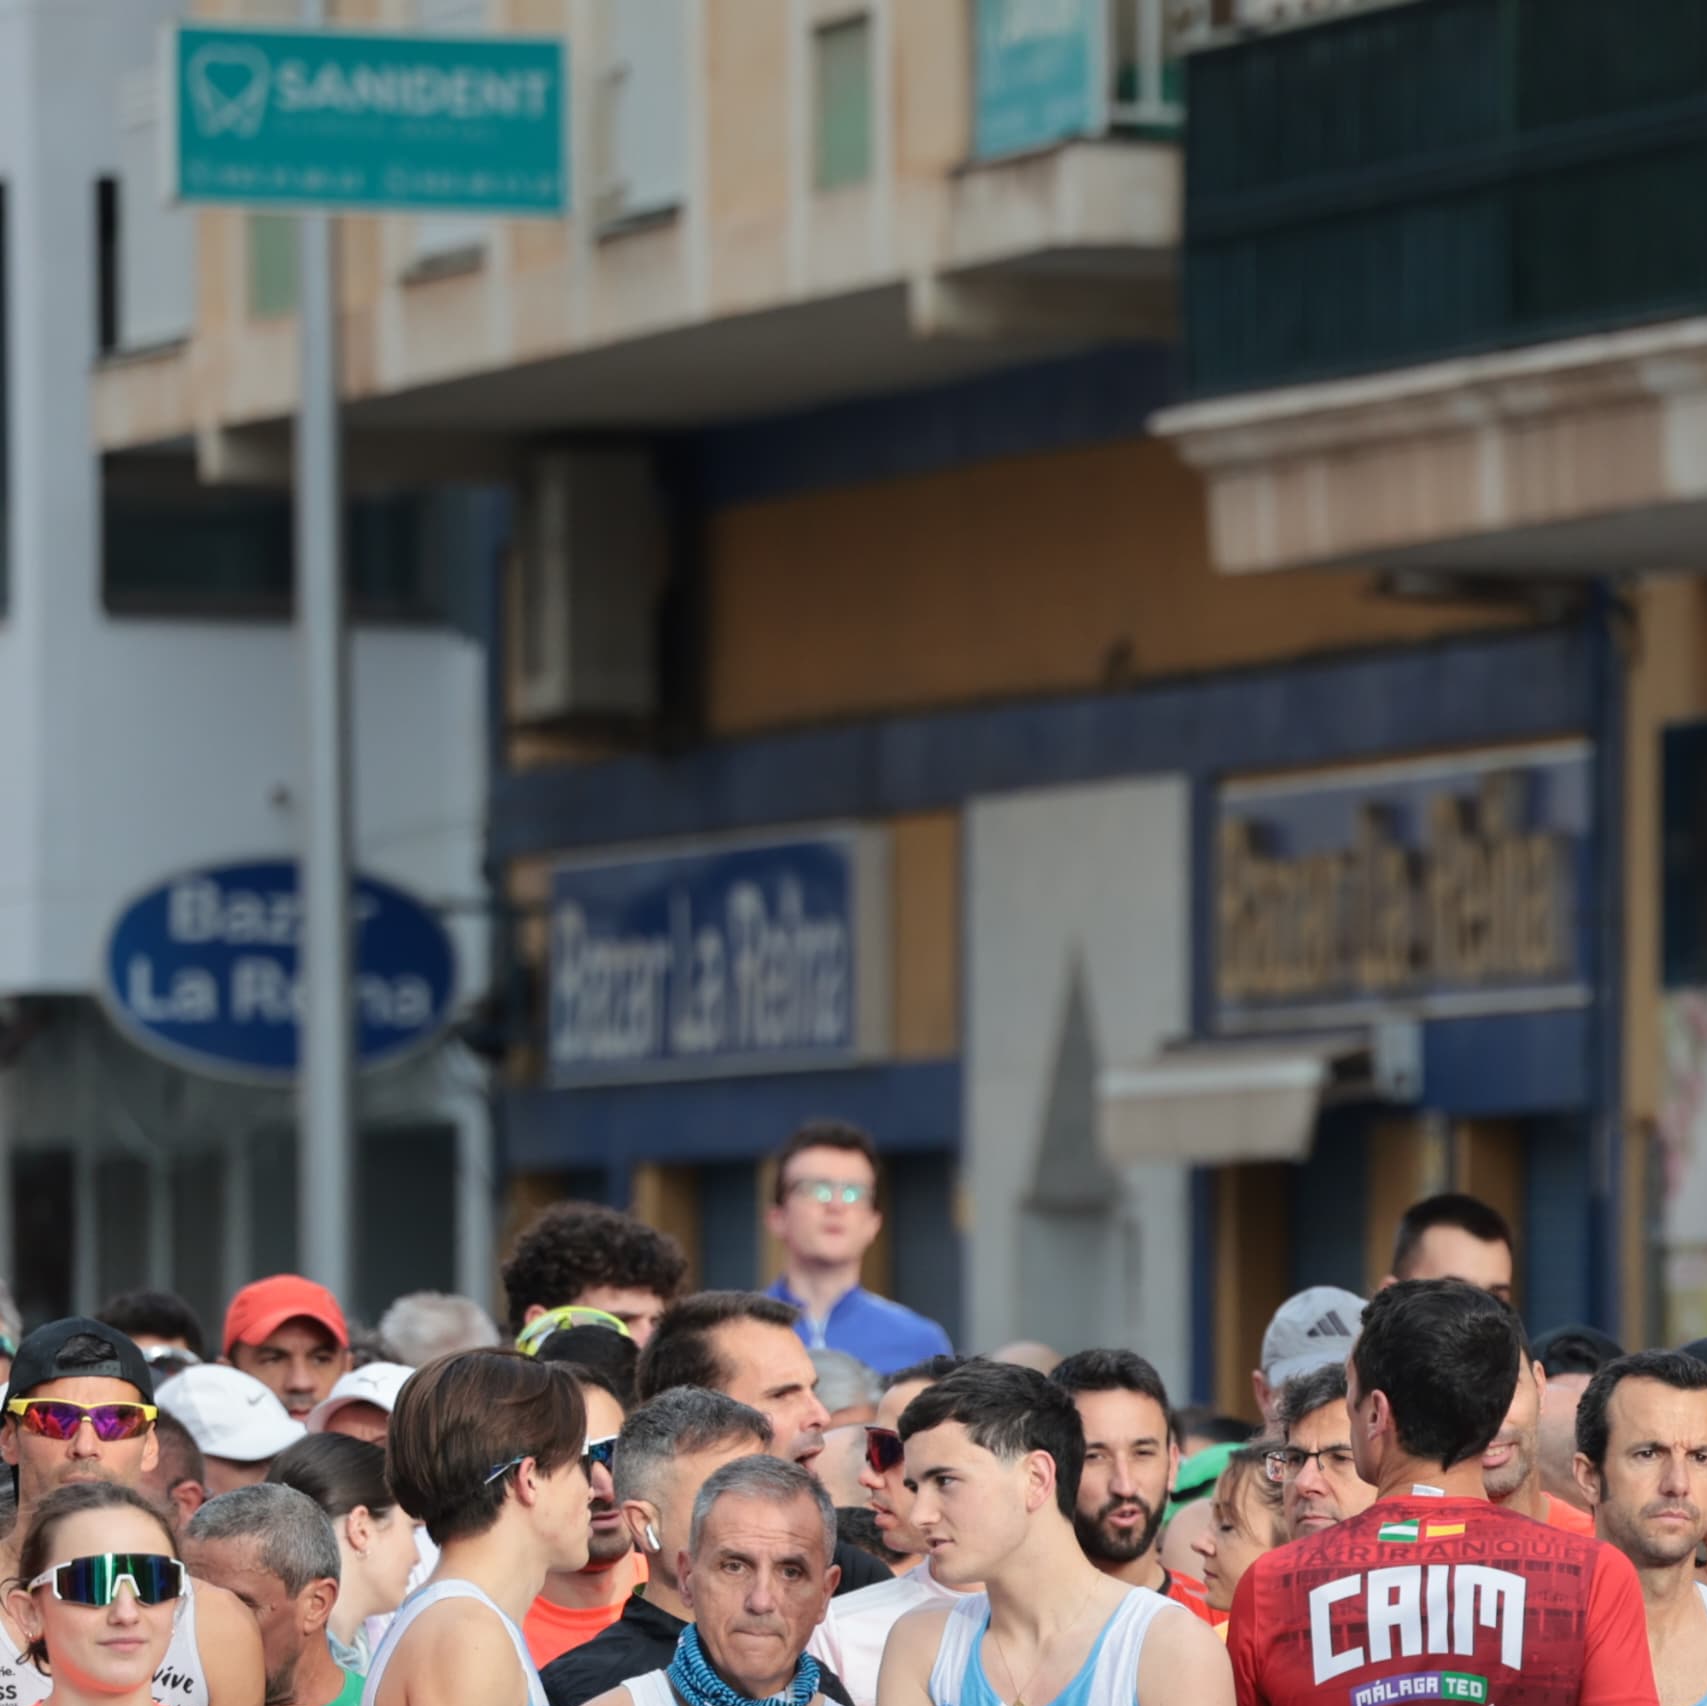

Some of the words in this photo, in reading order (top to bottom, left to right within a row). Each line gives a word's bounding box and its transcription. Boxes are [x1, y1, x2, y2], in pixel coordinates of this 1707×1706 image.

[275, 58, 549, 119] SANIDENT
[131, 957, 218, 1024] La
[1309, 1564, 1527, 1686] CAIM
